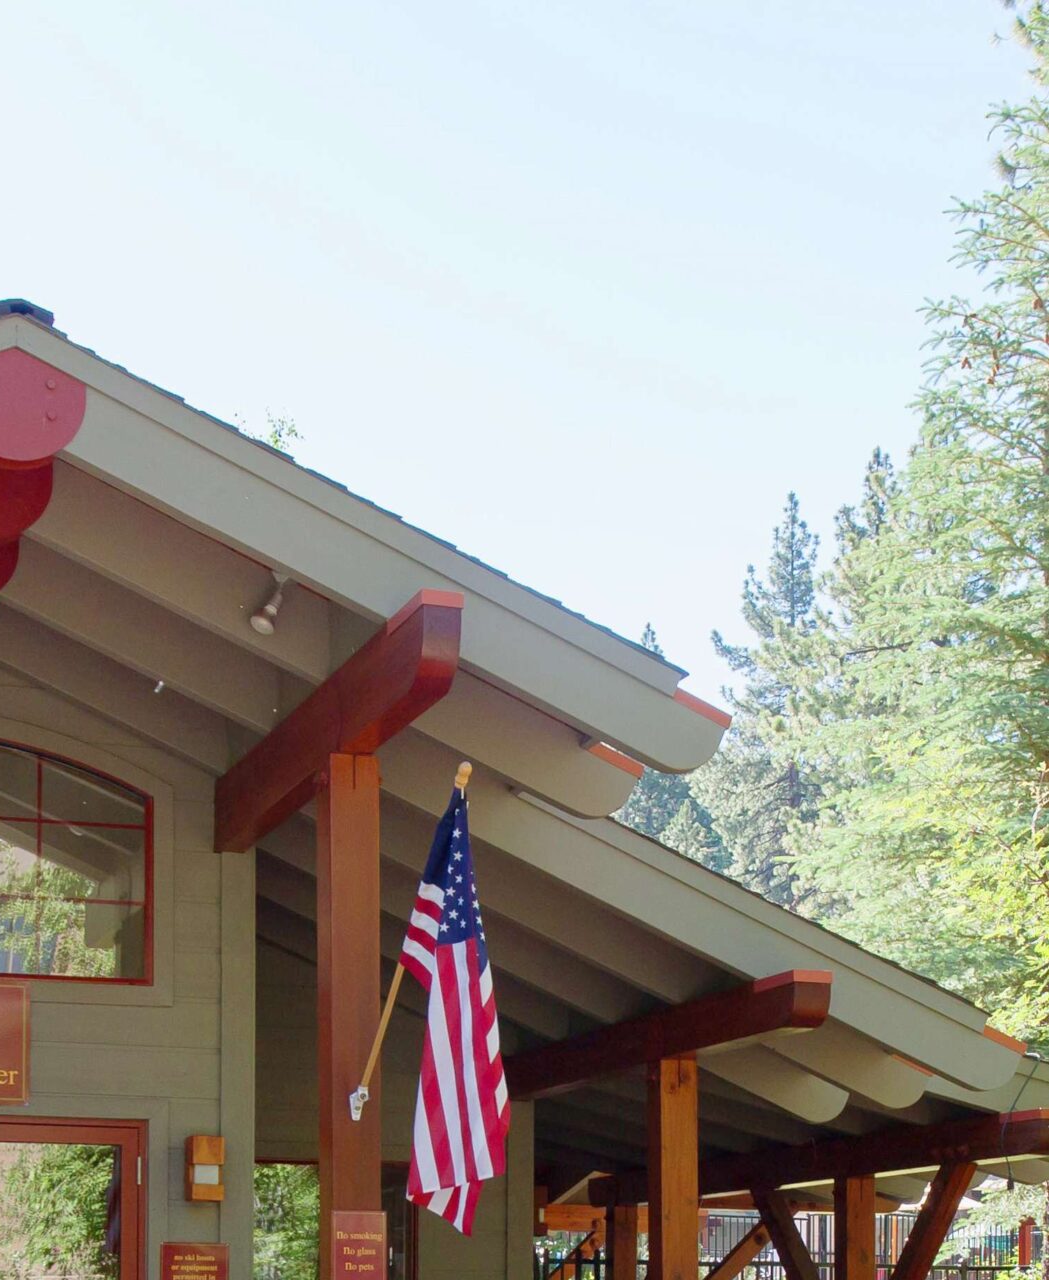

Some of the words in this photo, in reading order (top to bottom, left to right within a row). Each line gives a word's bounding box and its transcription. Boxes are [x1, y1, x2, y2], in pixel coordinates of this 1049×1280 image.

[350, 1231, 383, 1242] smoking
[357, 1247, 376, 1257] glass
[180, 1264, 218, 1272] equipment
[358, 1263, 374, 1273] pets
